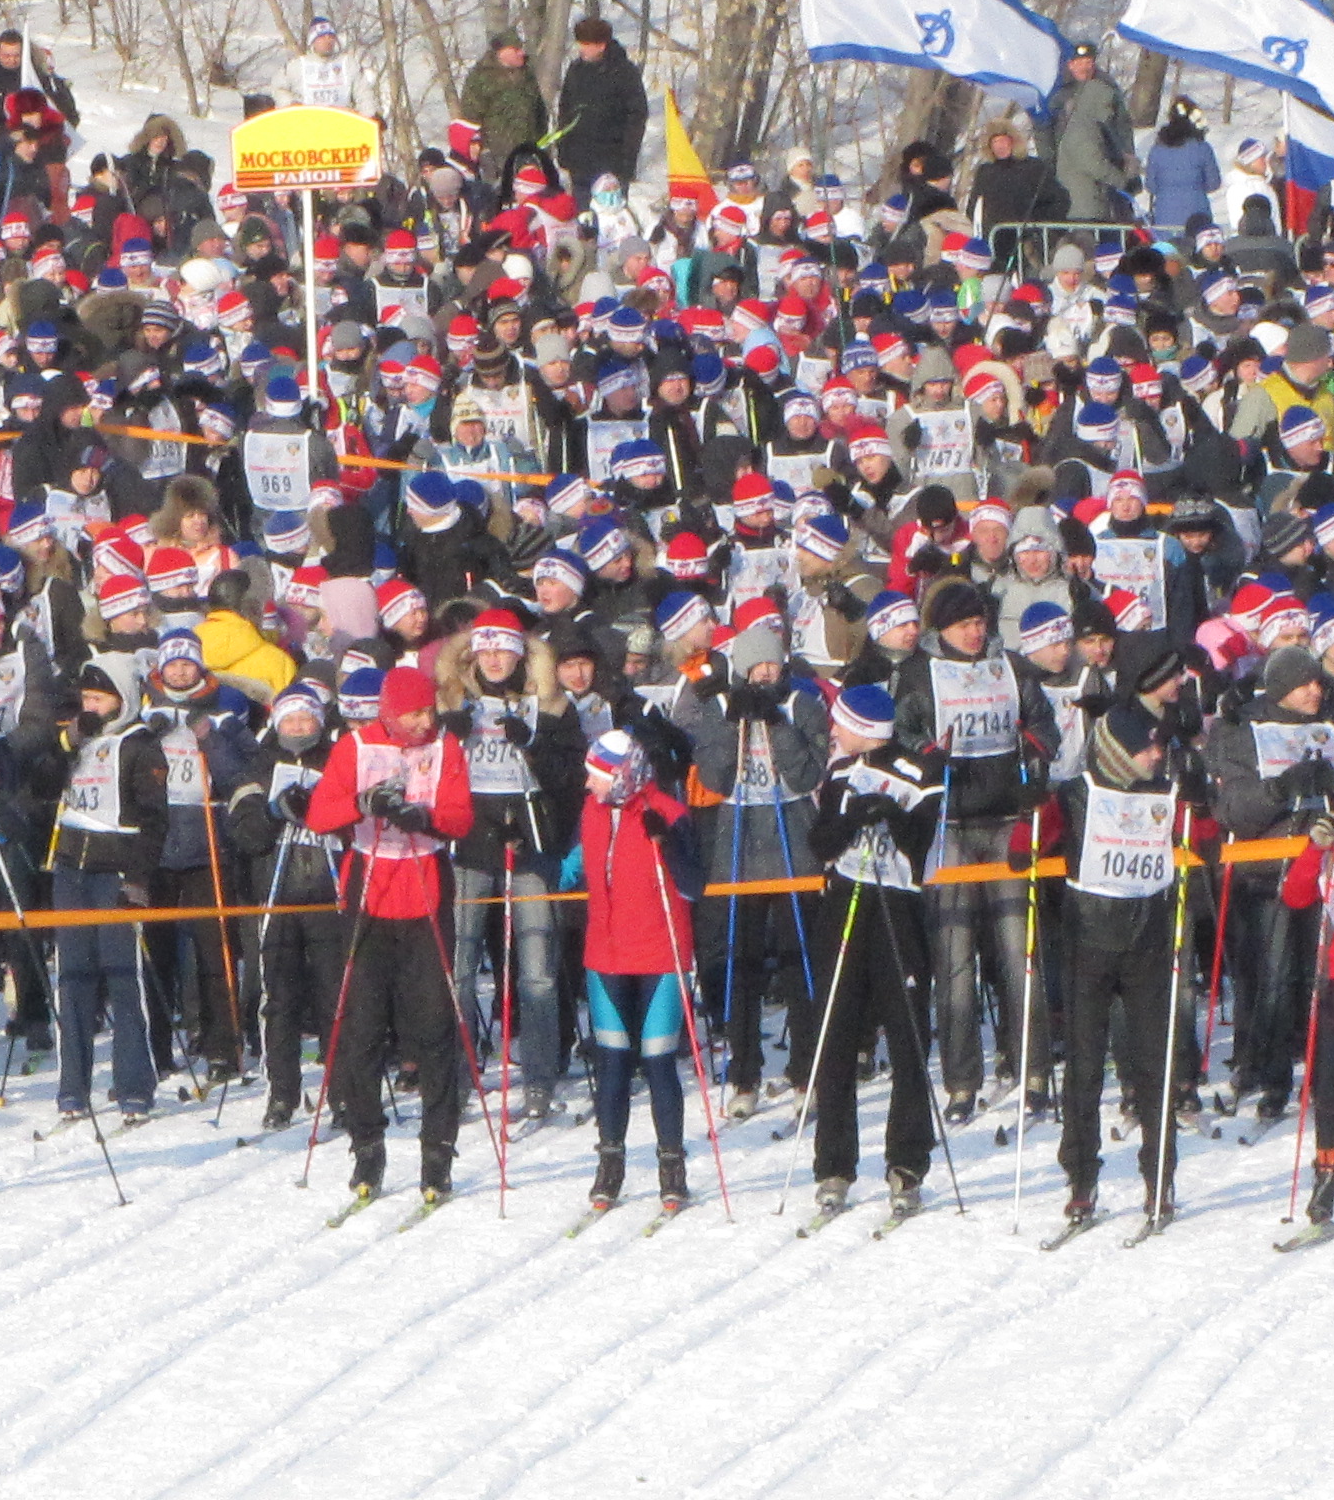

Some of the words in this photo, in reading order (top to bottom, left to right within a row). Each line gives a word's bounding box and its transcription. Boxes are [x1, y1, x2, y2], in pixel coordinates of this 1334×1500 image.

[240, 144, 372, 169] МОСКОВСКИЙ
[273, 170, 342, 185] РАЙОН
[261, 475, 292, 493] 969
[953, 711, 1012, 738] 12144
[1100, 849, 1165, 881] 10468
